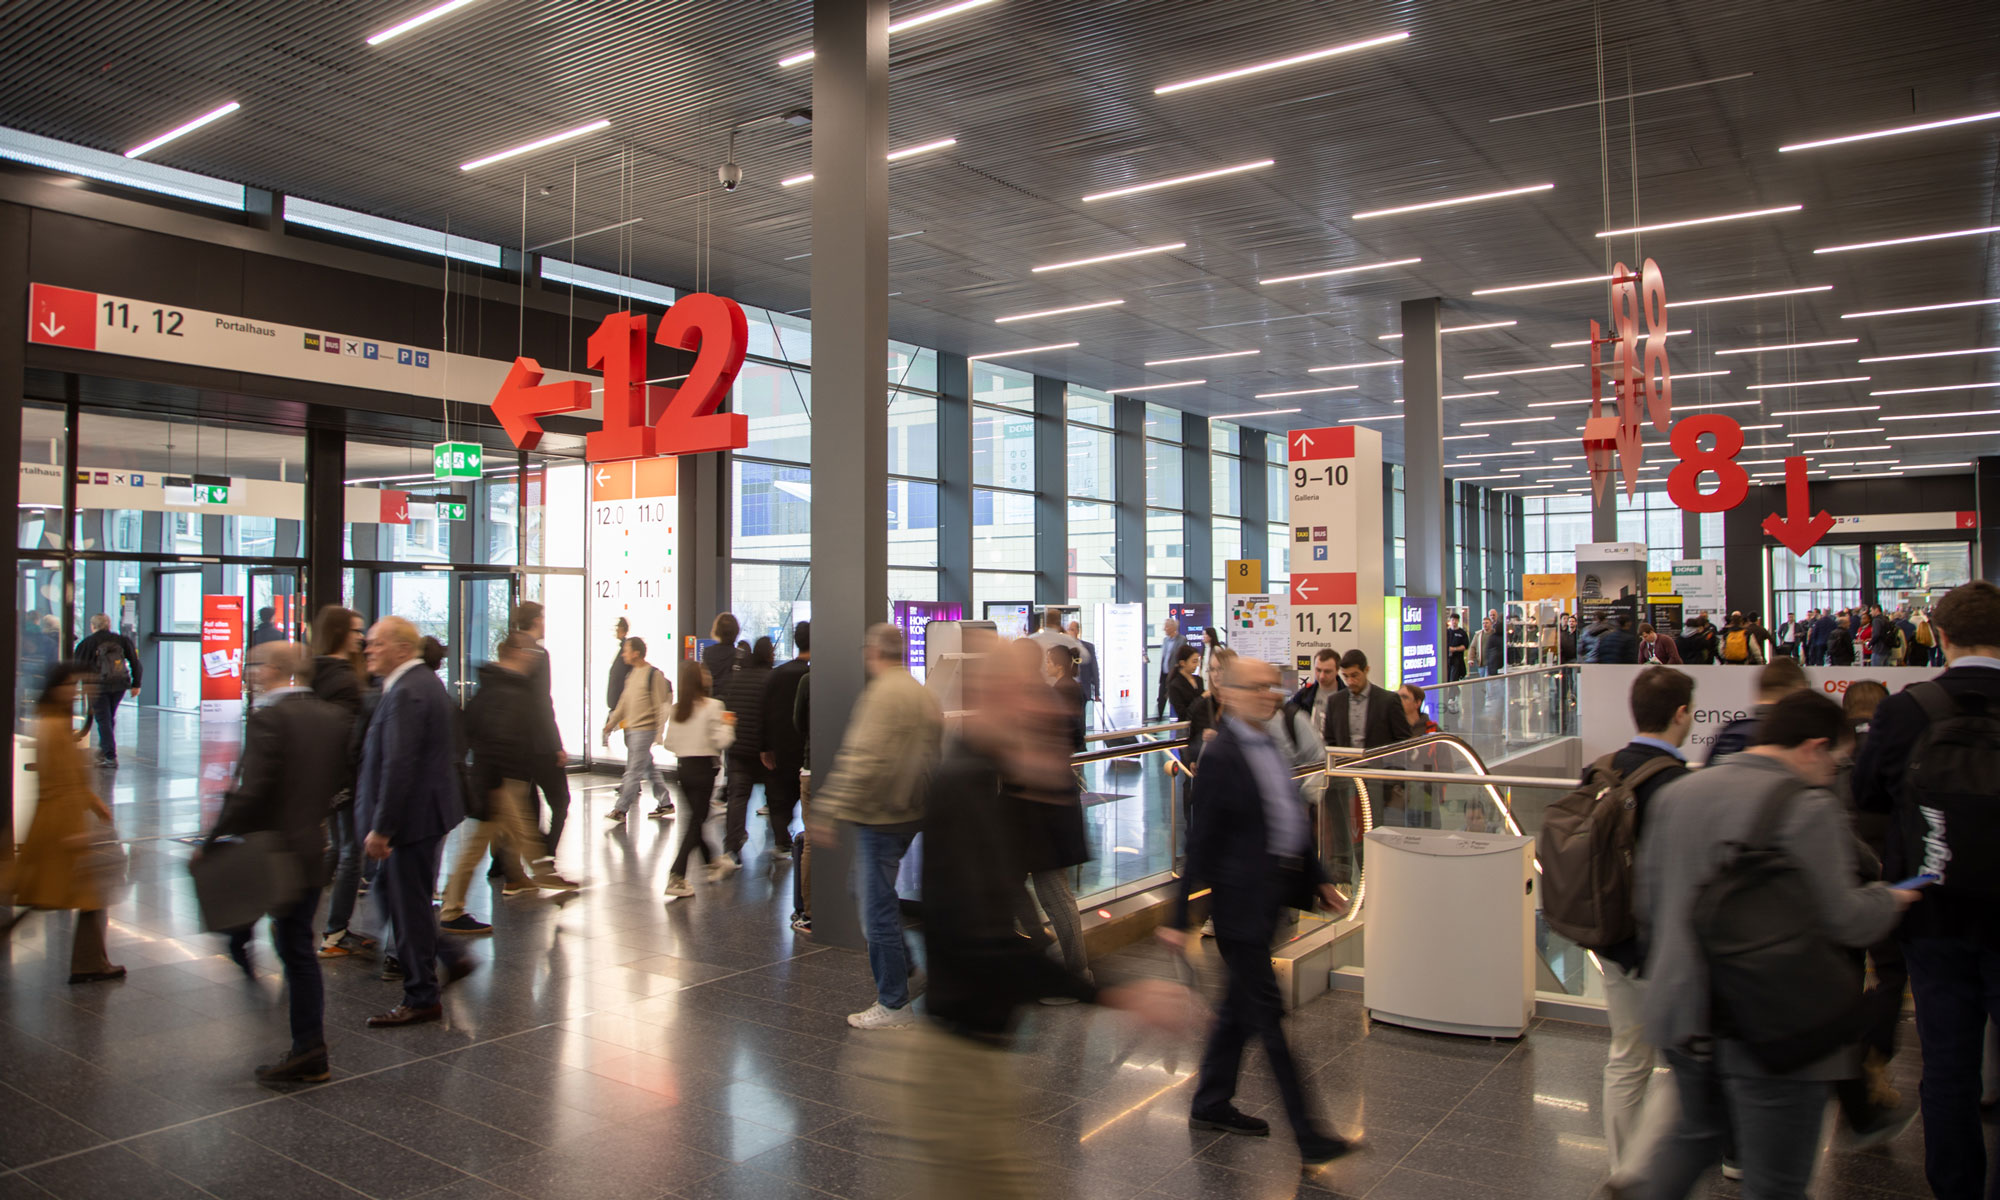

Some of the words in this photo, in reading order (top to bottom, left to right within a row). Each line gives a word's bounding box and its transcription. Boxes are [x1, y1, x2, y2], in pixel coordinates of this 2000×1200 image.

[102, 301, 139, 333] 11,
[152, 309, 184, 337] 12
[216, 318, 276, 338] Portalhaus
[325, 341, 339, 350] BUS
[367, 345, 375, 357] P
[401, 350, 409, 362] P
[417, 355, 428, 365] 12
[587, 292, 748, 462] 12
[1667, 414, 1749, 513] 8
[20, 467, 61, 478] rtalhaus
[1294, 494, 1320, 502] Galleria
[596, 505, 624, 525] 12.0
[638, 502, 664, 523] 11.0
[1316, 547, 1325, 559] P
[1239, 563, 1249, 577] 8
[596, 580, 620, 598] 12.1
[637, 580, 661, 598] 11.1
[909, 626, 926, 635] KON
[1296, 612, 1321, 635] 11,
[1328, 612, 1352, 632] 12
[1693, 709, 1747, 723] ense
[1691, 734, 1718, 746] Expl
